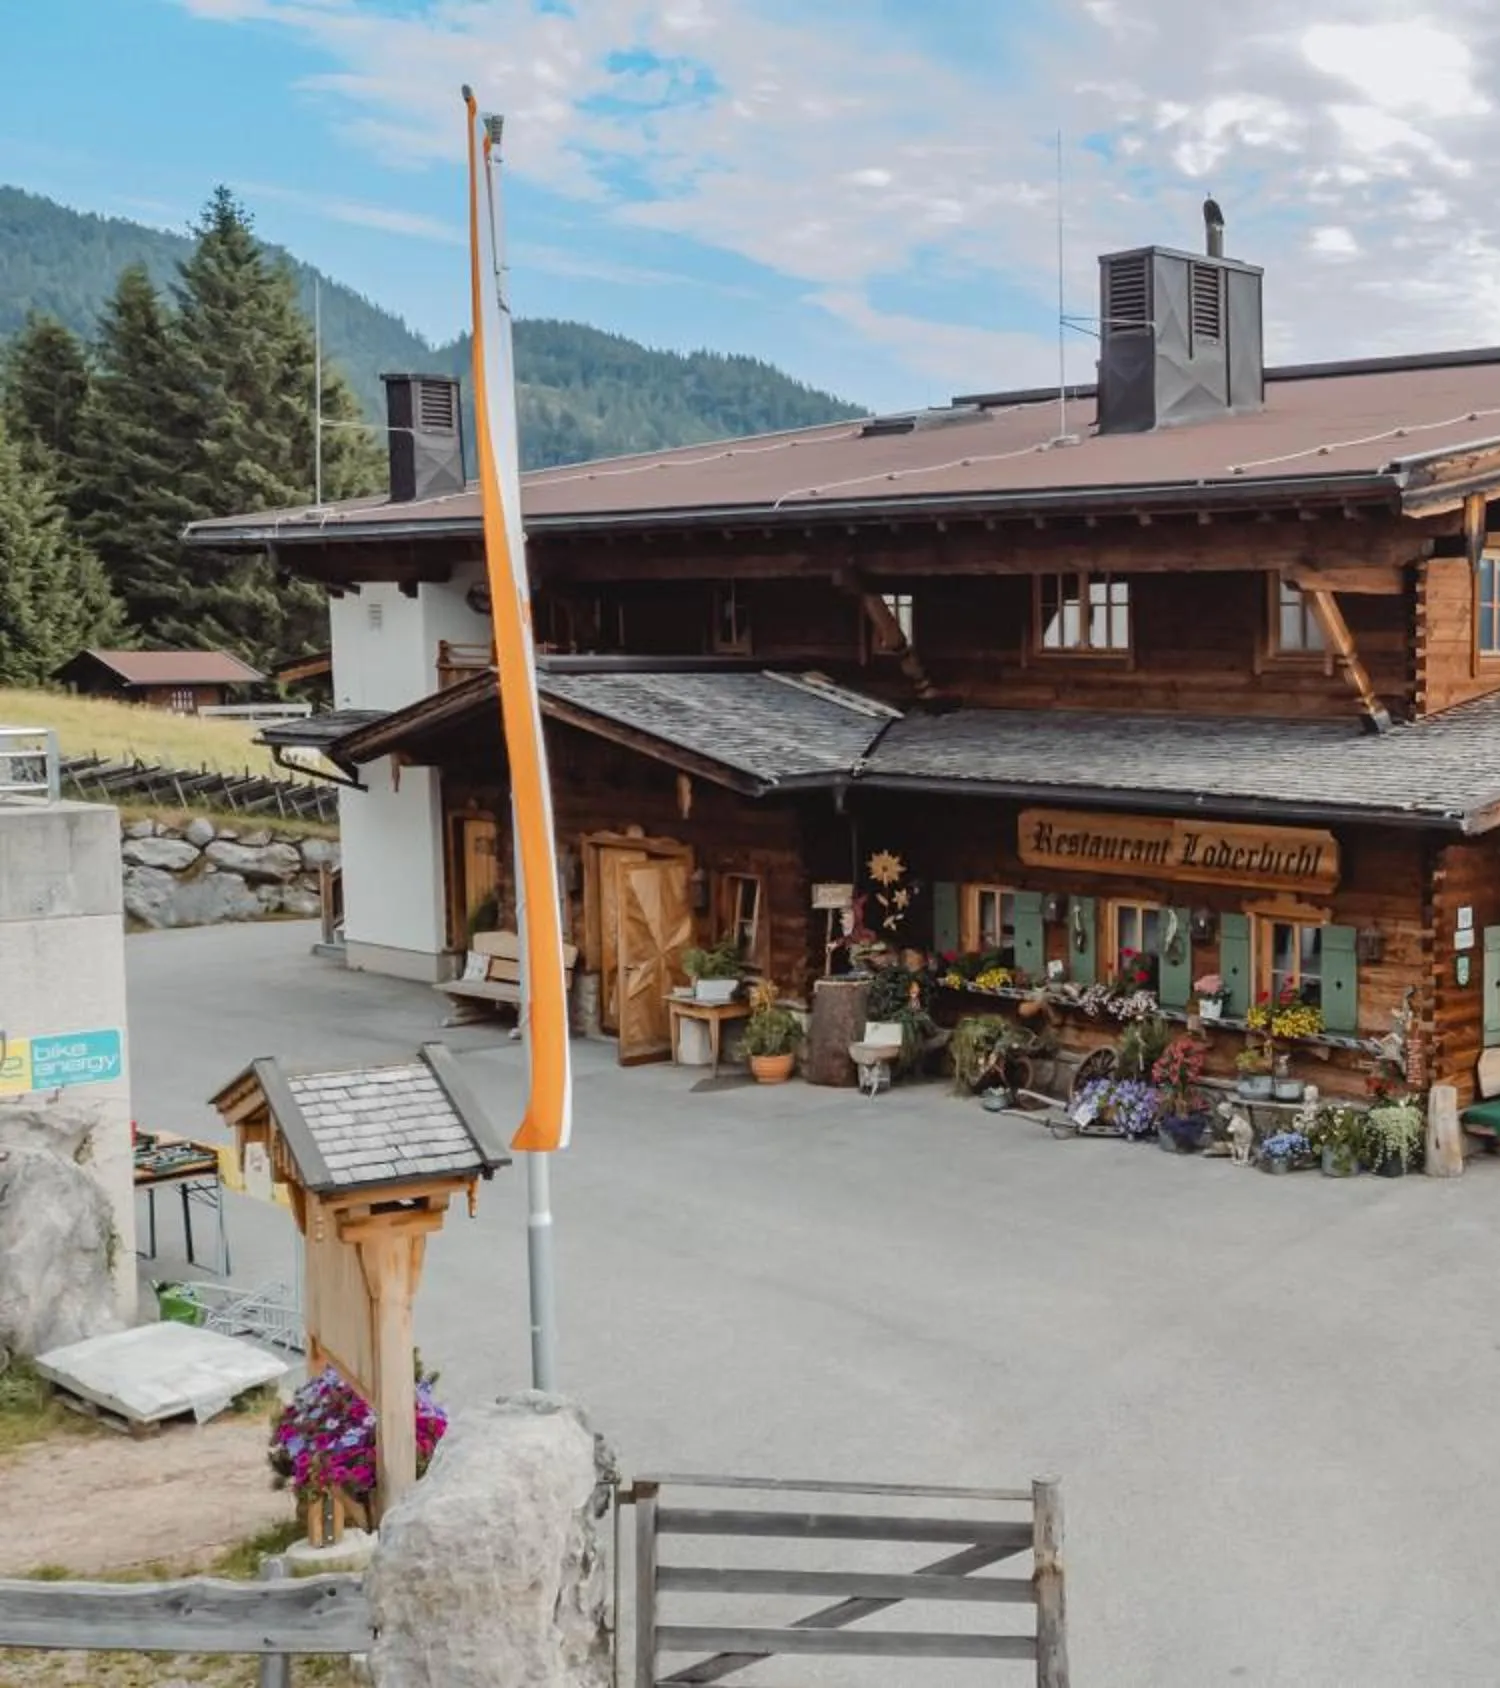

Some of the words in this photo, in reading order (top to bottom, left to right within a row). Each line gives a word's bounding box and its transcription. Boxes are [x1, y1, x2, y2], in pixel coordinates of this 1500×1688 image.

[1033, 822, 1172, 865] Restaurant
[1179, 832, 1322, 877] Loderbichl
[33, 1041, 88, 1061] bike
[33, 1055, 117, 1077] energy
